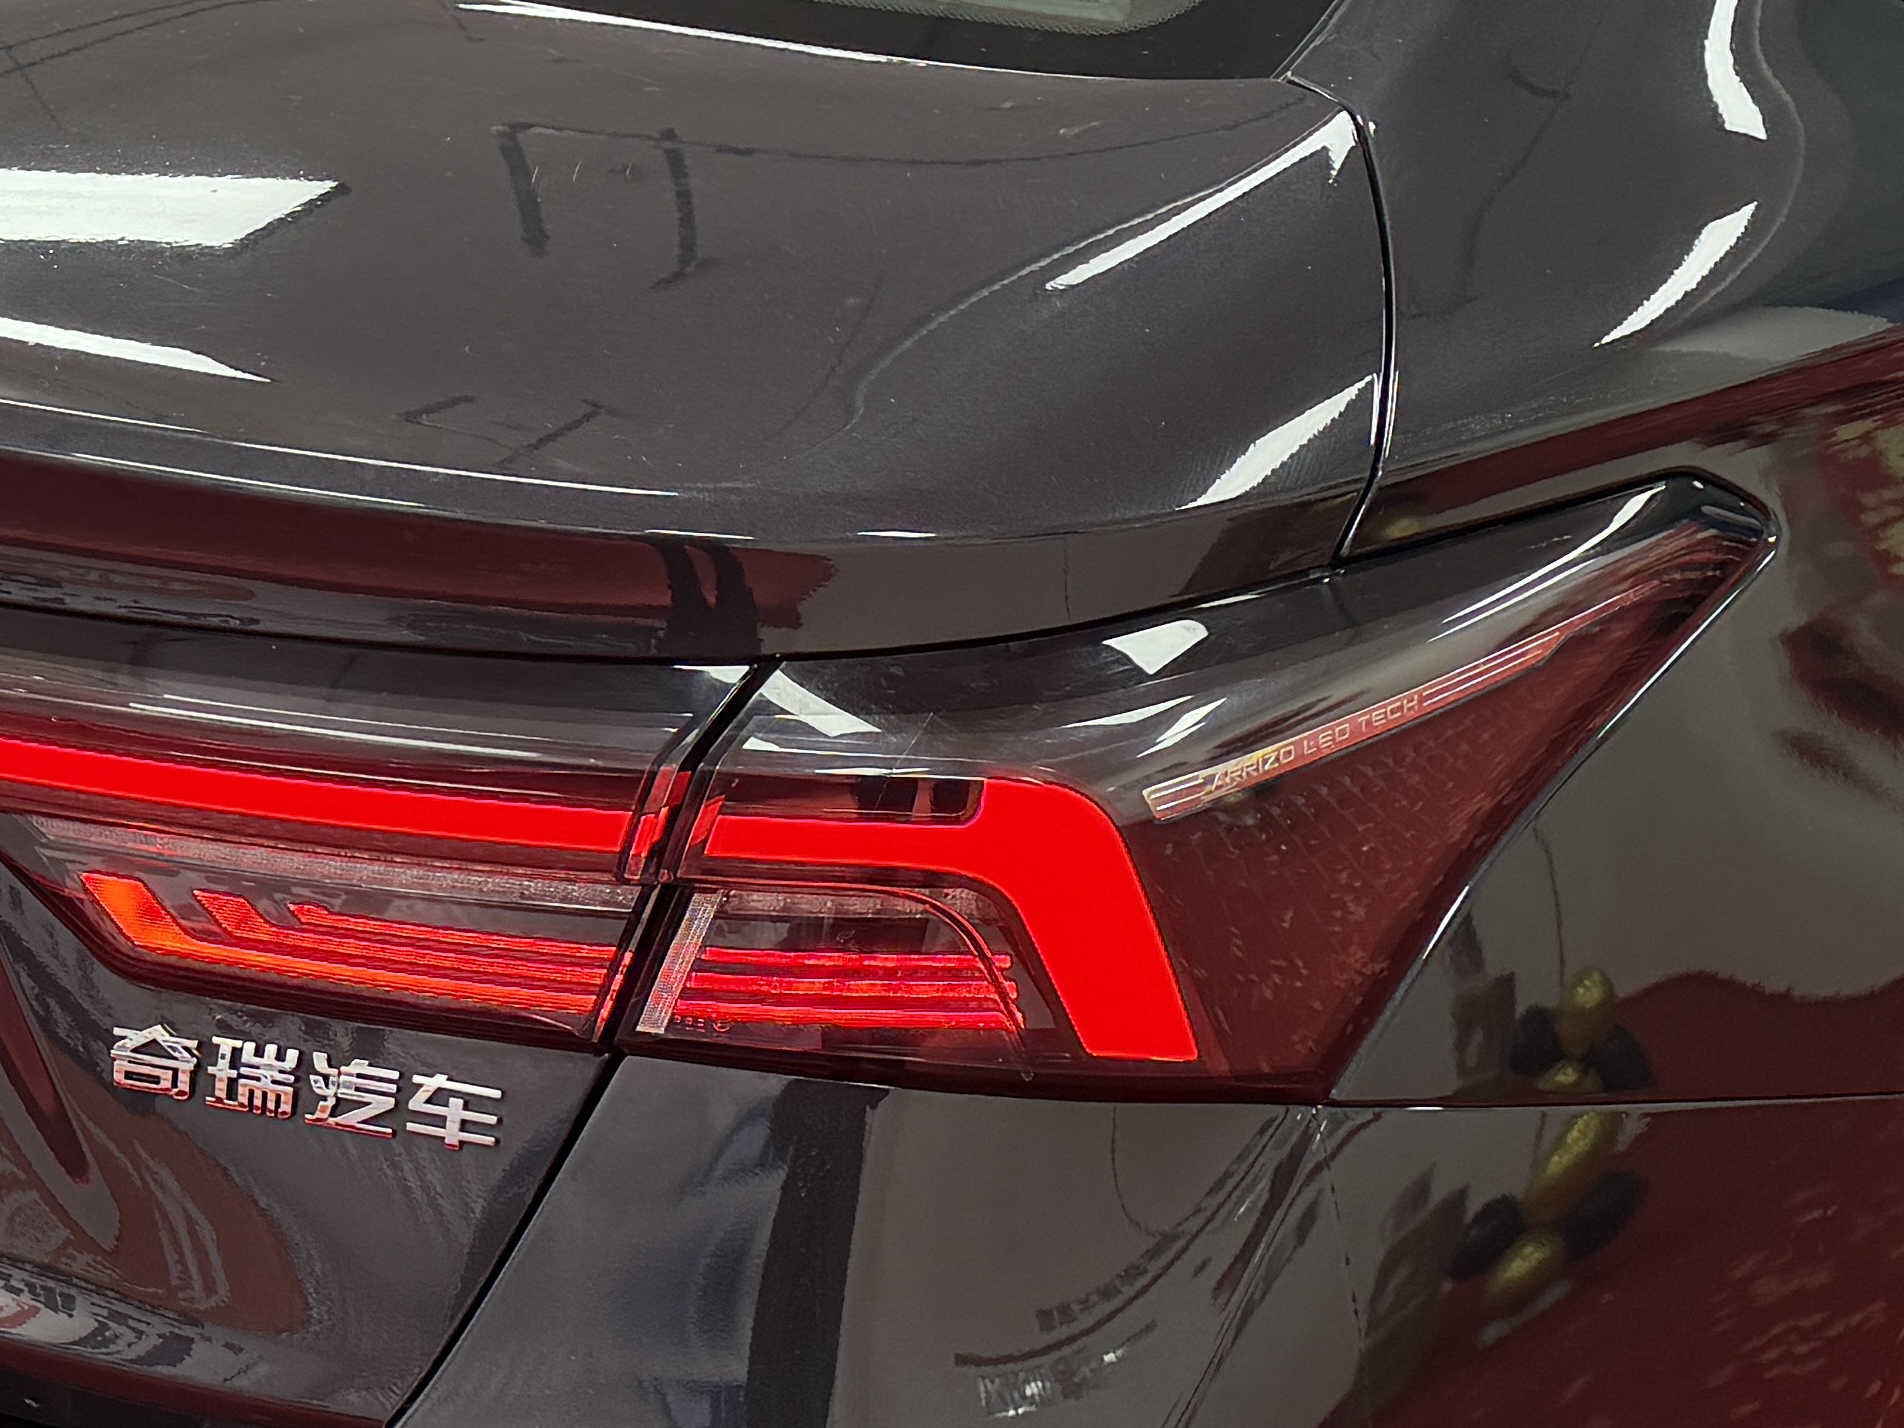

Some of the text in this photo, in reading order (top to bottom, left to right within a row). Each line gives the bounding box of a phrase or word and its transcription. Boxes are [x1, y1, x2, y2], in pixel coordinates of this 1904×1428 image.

[1209, 694, 1420, 793] ARRIZO LED TECH
[109, 1023, 503, 1151] 奇瑞汽车
